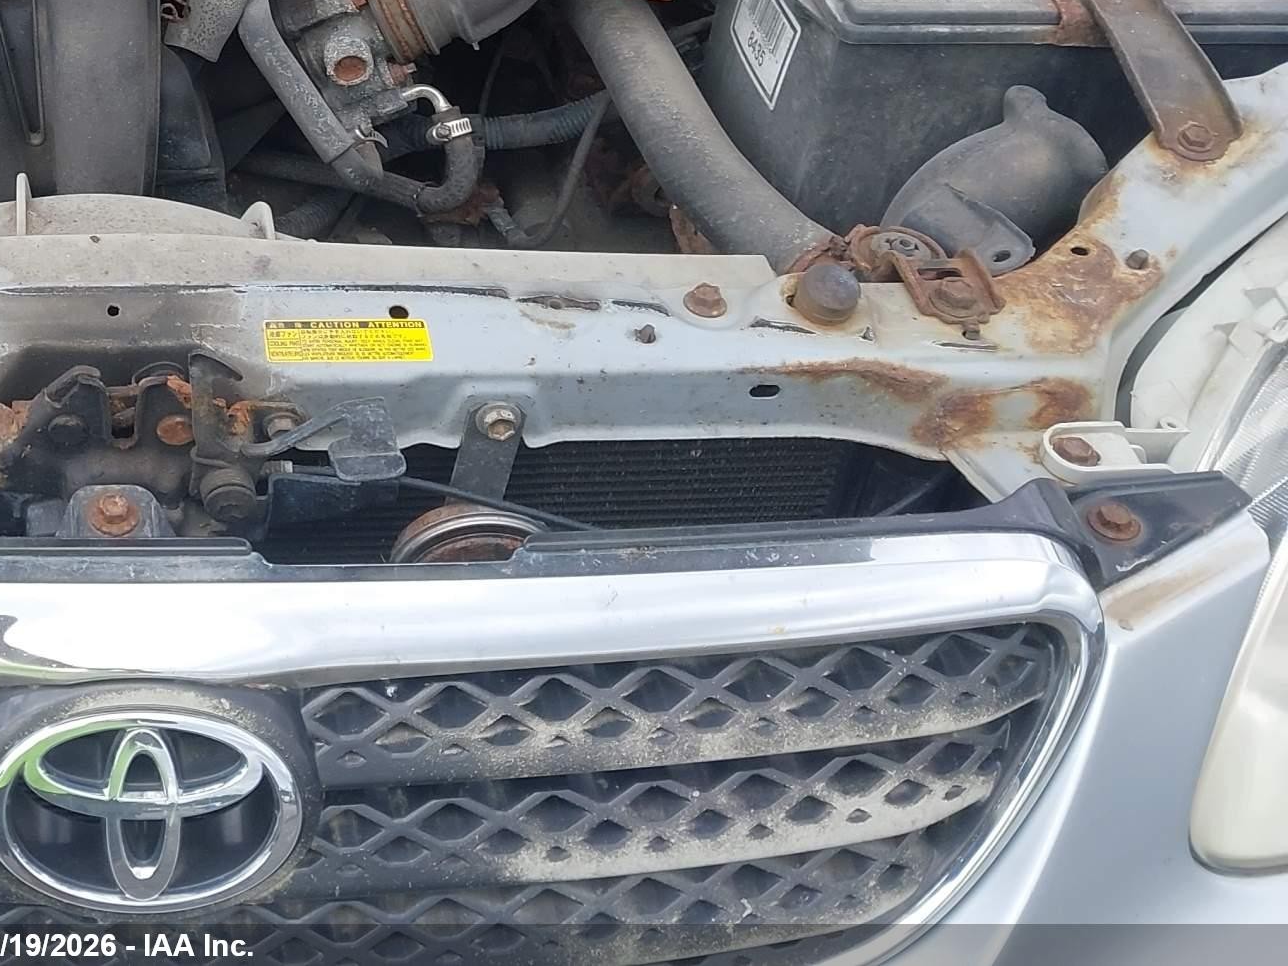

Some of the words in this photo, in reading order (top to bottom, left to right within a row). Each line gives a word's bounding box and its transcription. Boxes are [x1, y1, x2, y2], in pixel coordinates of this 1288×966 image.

[747, 30, 766, 67] 8435
[310, 321, 360, 329] CAUTION
[367, 320, 423, 328] ATTENTION
